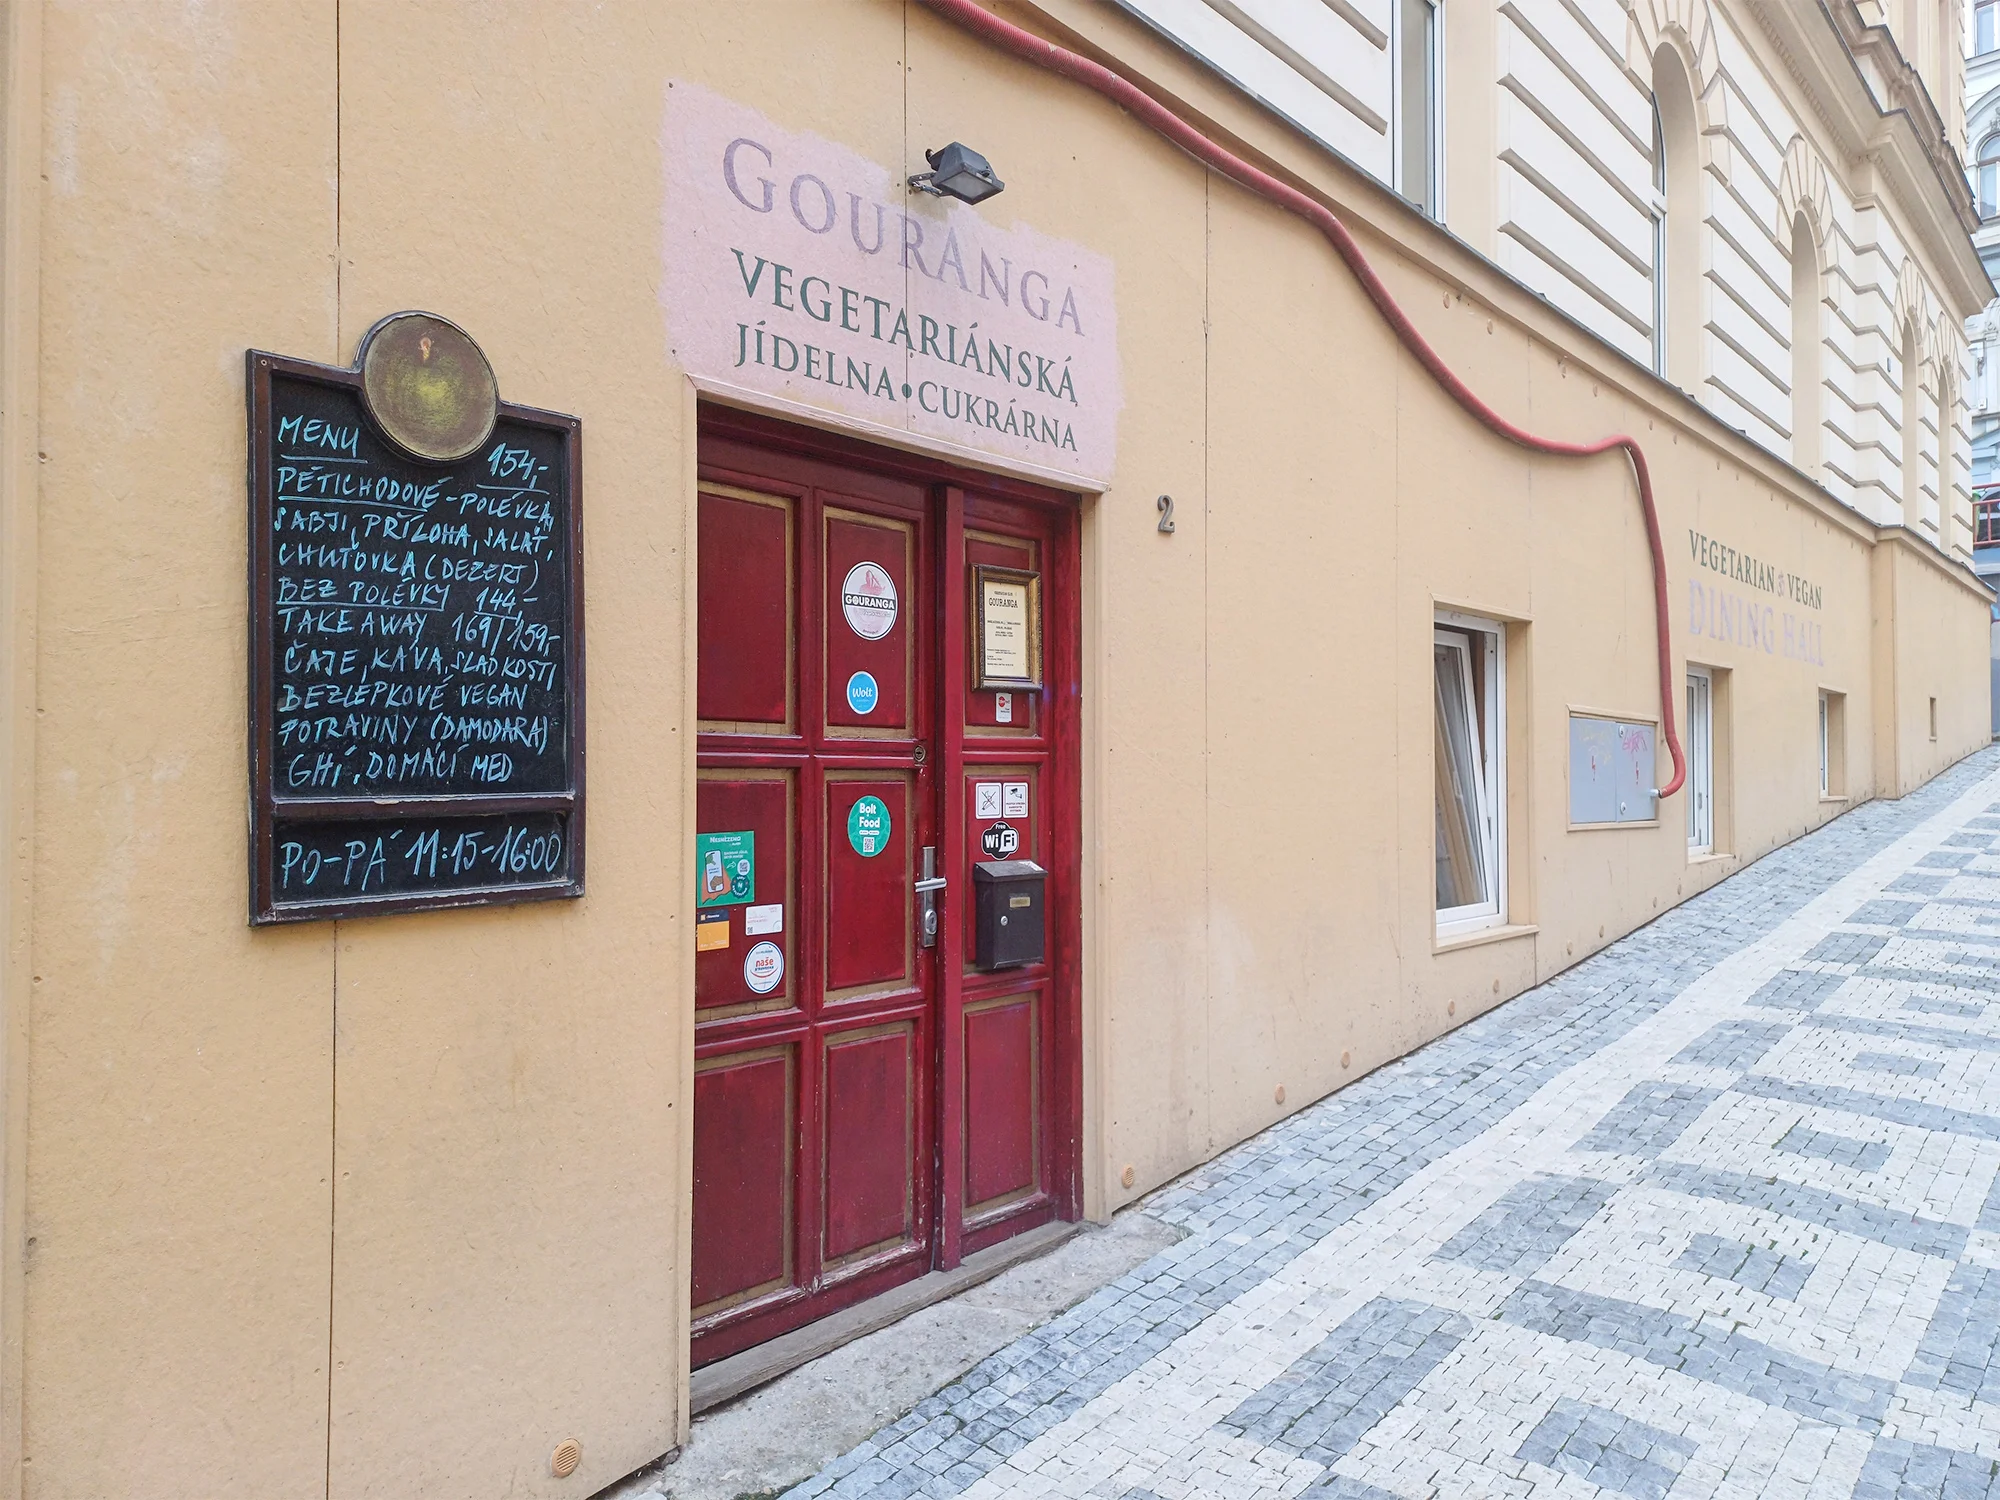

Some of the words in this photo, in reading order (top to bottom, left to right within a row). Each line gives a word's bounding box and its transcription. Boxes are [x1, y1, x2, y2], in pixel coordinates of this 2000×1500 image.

[723, 137, 1085, 337] GOURANGA
[730, 247, 1078, 403] VEGETARIÁNSKÁ
[734, 320, 897, 402] JÍDELNA
[918, 380, 1078, 452] CUKRÁRNA
[277, 414, 360, 459] MENU
[487, 442, 549, 490] 154,-
[1157, 495, 1175, 534] 2
[1688, 528, 1775, 594] VEGETARIAN
[1787, 573, 1822, 611] VEGAN
[277, 575, 338, 602] BEZ
[348, 576, 451, 611] POLÉVKY
[845, 594, 895, 610] GOURANGA
[277, 606, 355, 635] TAKE
[360, 611, 428, 644] AWAY
[1688, 578, 1775, 655] DINING
[460, 682, 528, 710] VEGAN
[852, 687, 873, 698] Wolt
[277, 712, 419, 746] POTRAVINY
[470, 752, 514, 783] MED
[859, 802, 877, 815] Bolt
[859, 816, 881, 828] Food
[755, 957, 774, 968] naše
